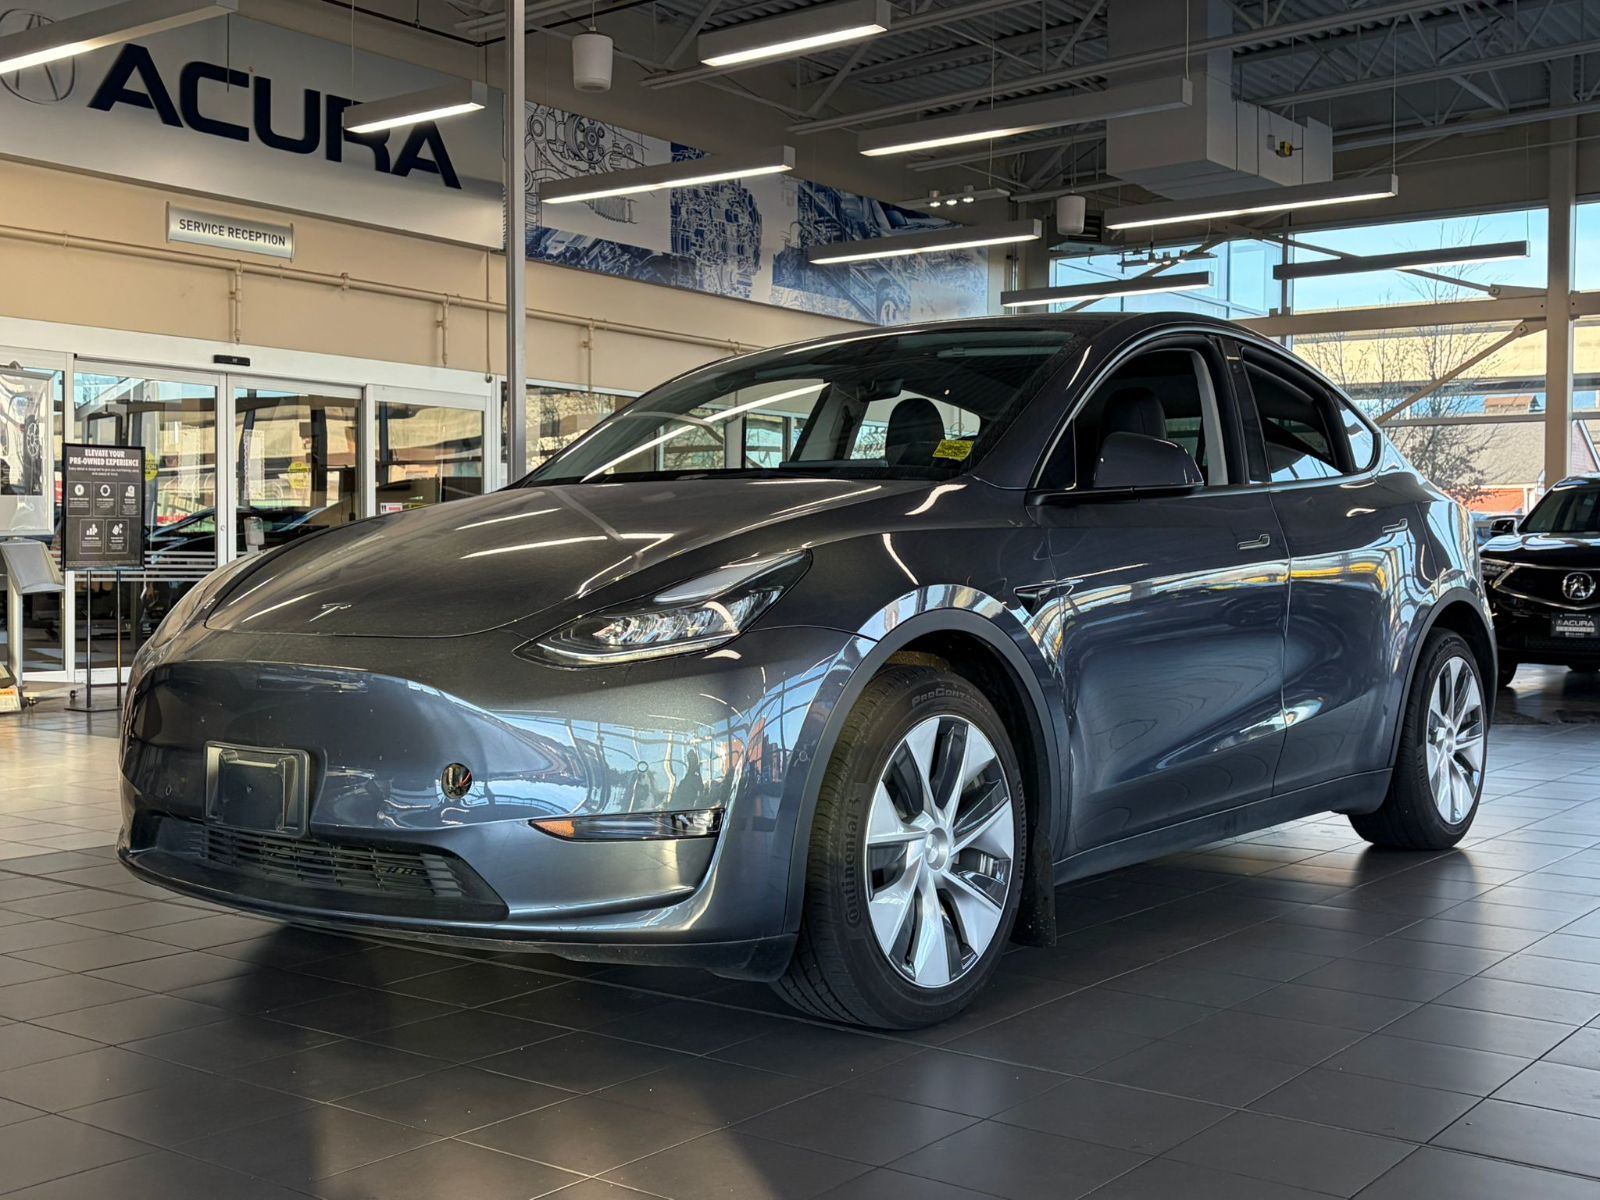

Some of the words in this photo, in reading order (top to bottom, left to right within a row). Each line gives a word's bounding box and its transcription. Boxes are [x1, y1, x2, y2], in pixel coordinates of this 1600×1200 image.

[87, 43, 462, 190] ACURA
[179, 219, 225, 237] SERVICE
[227, 227, 286, 247] RECEPTION
[69, 456, 105, 466] PRE-OWNED
[106, 458, 139, 467] EXPERIENCE
[85, 449, 109, 457] ELEVATE
[109, 450, 125, 458] YOUR
